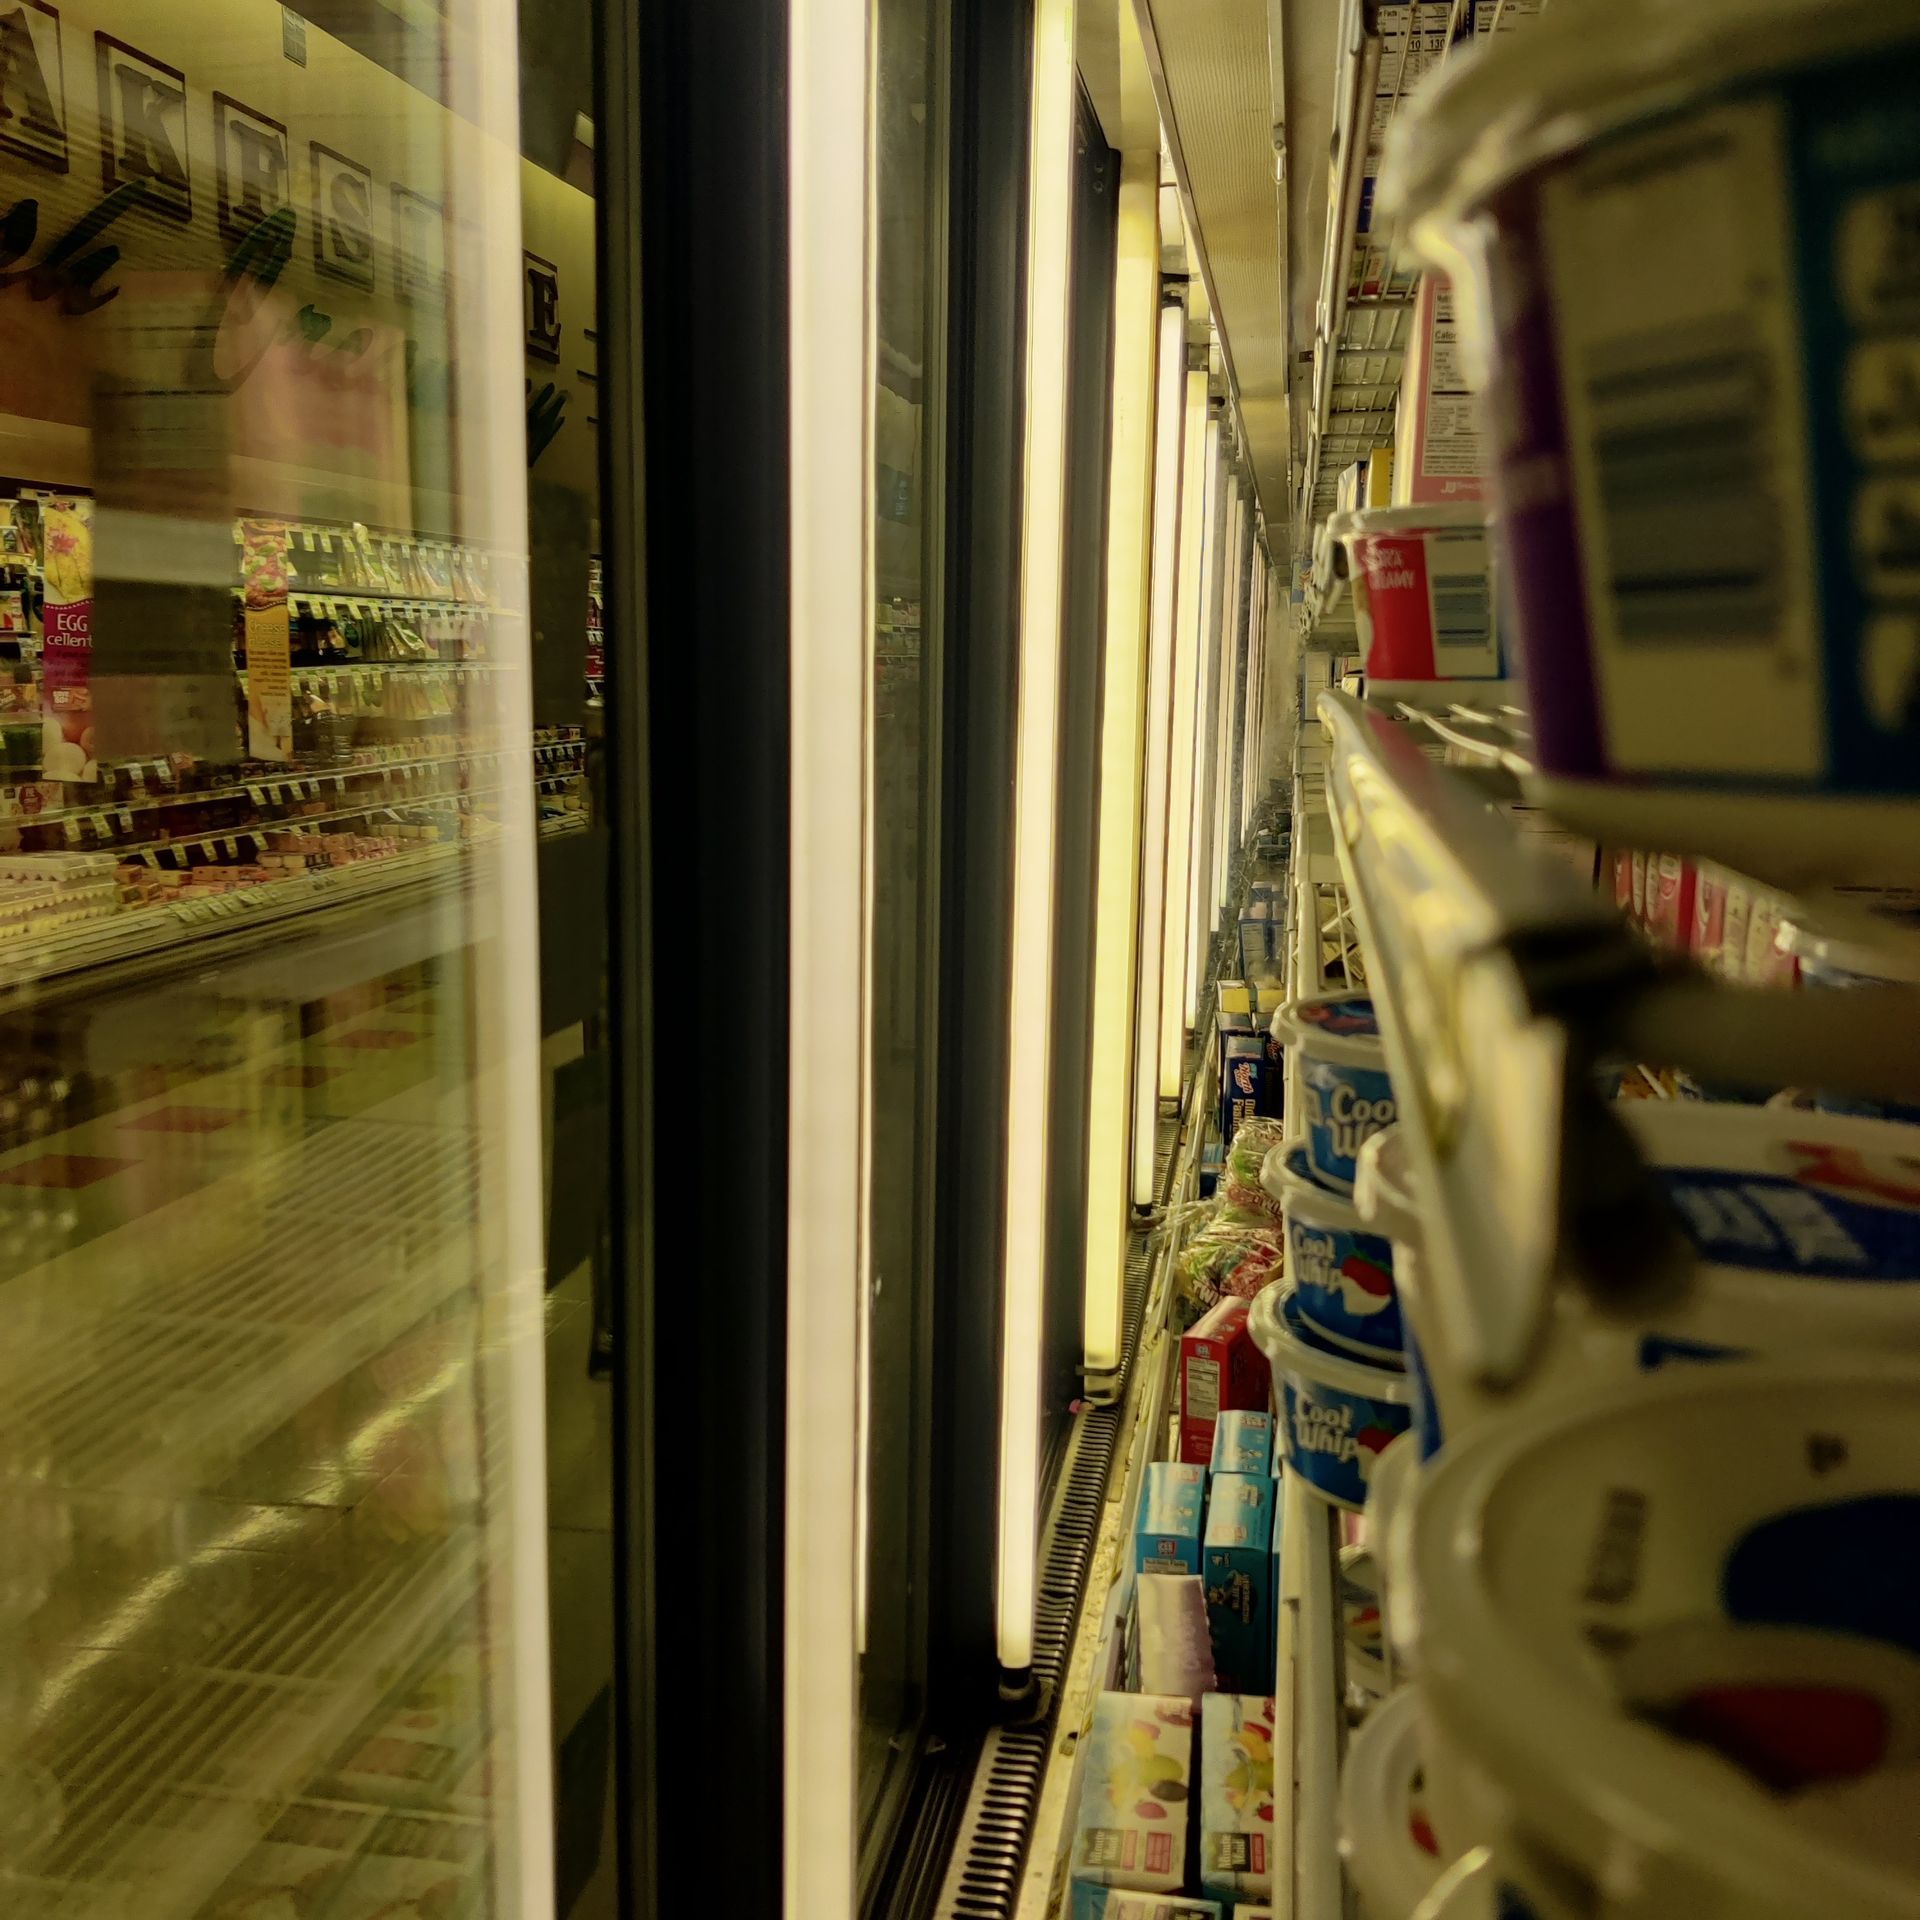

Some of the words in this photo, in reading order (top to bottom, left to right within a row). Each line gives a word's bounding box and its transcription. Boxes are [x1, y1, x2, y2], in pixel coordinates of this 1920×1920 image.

[46, 632, 93, 648] cellent
[57, 613, 88, 633] EGG
[1330, 1084, 1396, 1124] Coo
[1293, 1225, 1336, 1260] Cool
[1295, 1254, 1343, 1296] Whip
[1297, 1391, 1351, 1432] Cool
[1294, 1420, 1360, 1463] Whip
[1217, 1833, 1232, 1869] Minute
